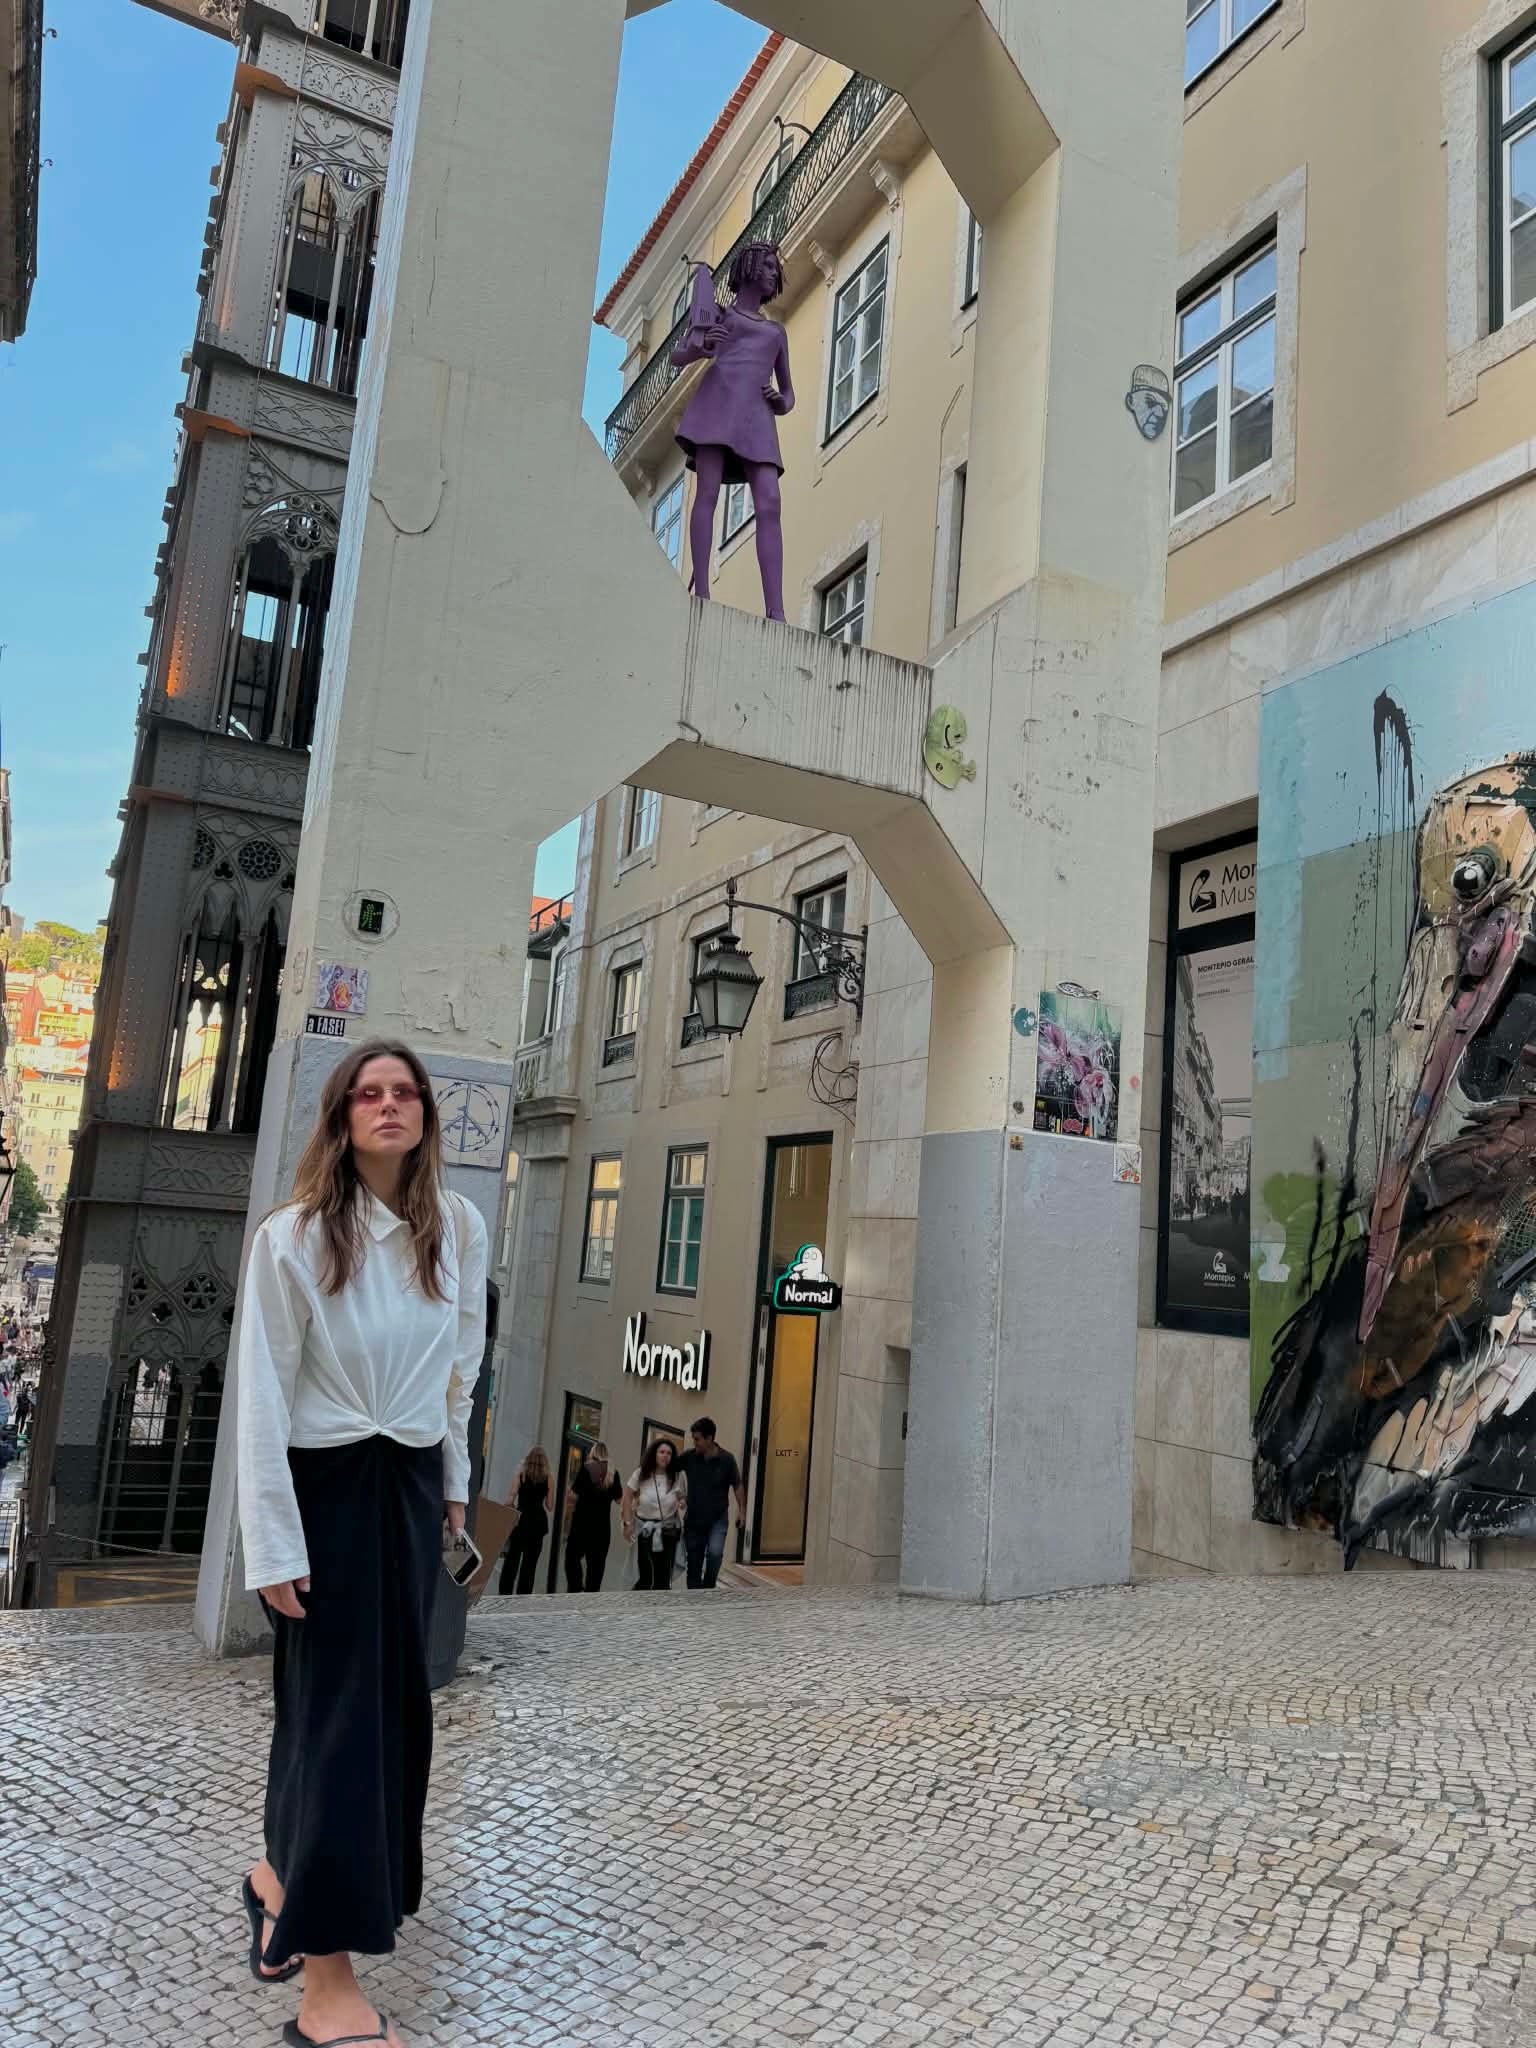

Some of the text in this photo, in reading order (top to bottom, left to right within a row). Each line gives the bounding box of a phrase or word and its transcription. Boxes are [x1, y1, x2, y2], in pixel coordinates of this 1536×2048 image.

[1232, 955, 1255, 967] GERAL
[316, 1016, 345, 1036] FASE!
[785, 1283, 833, 1304] Normal
[622, 1311, 706, 1391] Normal
